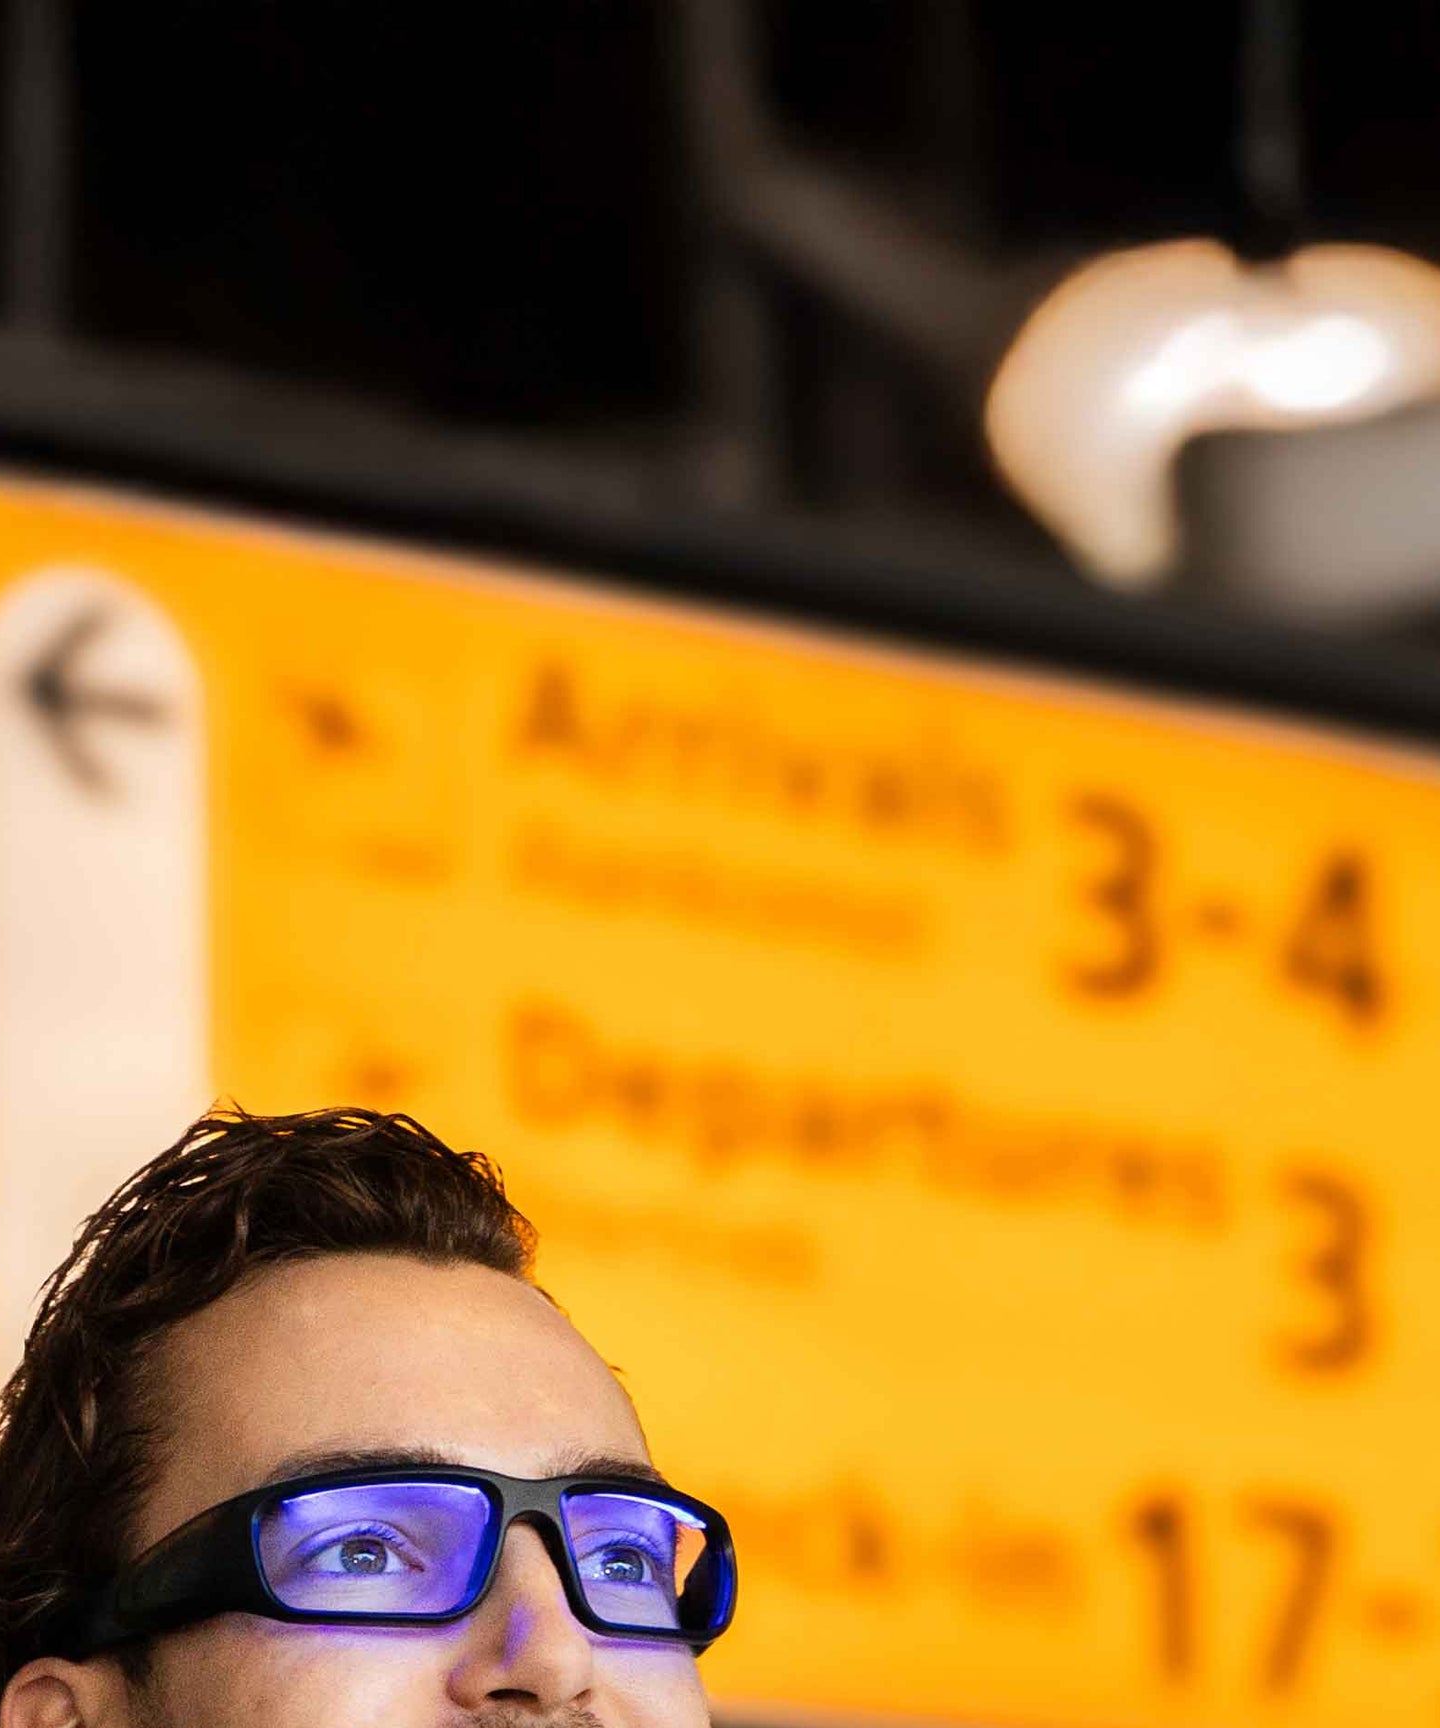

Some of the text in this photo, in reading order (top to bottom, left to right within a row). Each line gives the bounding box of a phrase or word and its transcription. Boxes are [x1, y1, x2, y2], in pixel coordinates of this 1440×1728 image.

[510, 655, 1020, 862] Arrivals
[1052, 785, 1405, 1042] 3-4
[500, 1000, 1387, 1388] Departures 3
